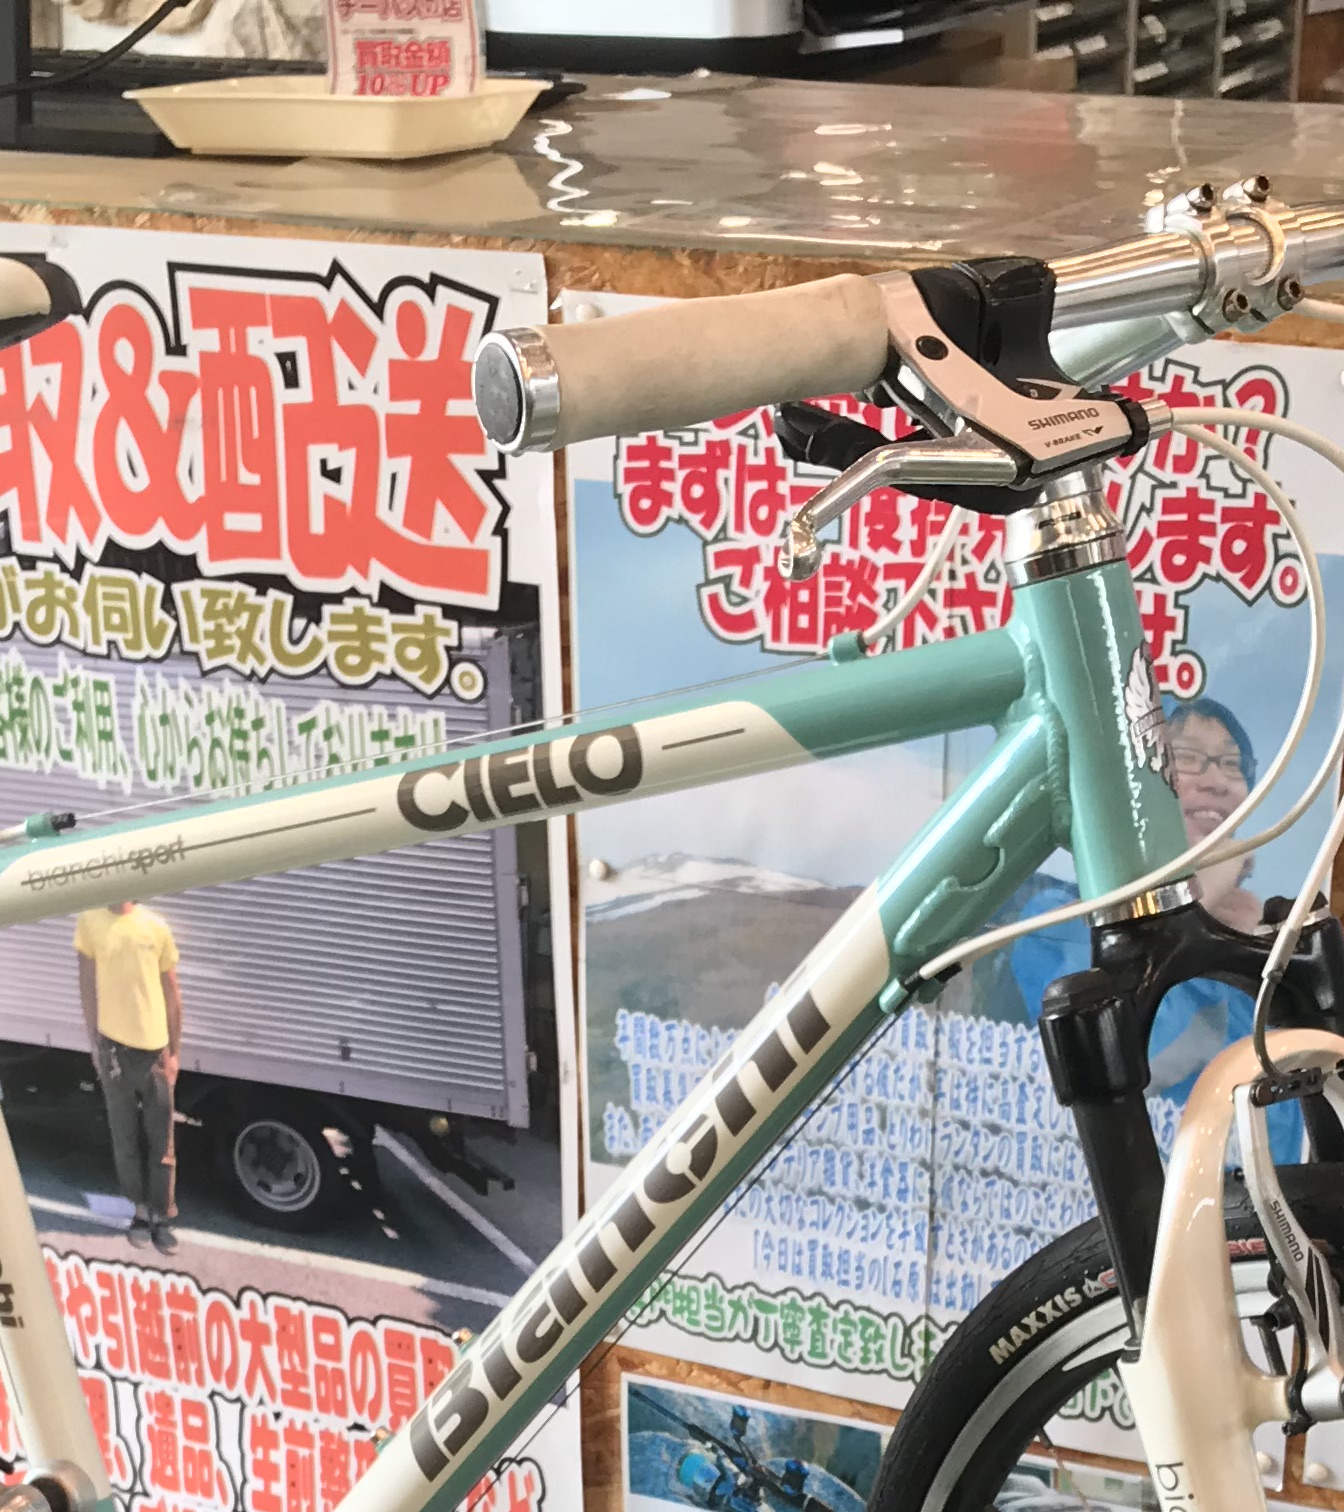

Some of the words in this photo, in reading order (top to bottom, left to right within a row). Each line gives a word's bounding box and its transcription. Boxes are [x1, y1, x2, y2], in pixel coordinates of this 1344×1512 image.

[1027, 406, 1101, 432] SHIMANO
[397, 723, 644, 832] CIELO
[1270, 1199, 1305, 1264] SHIMANO
[988, 1286, 1084, 1366] MAXXIS
